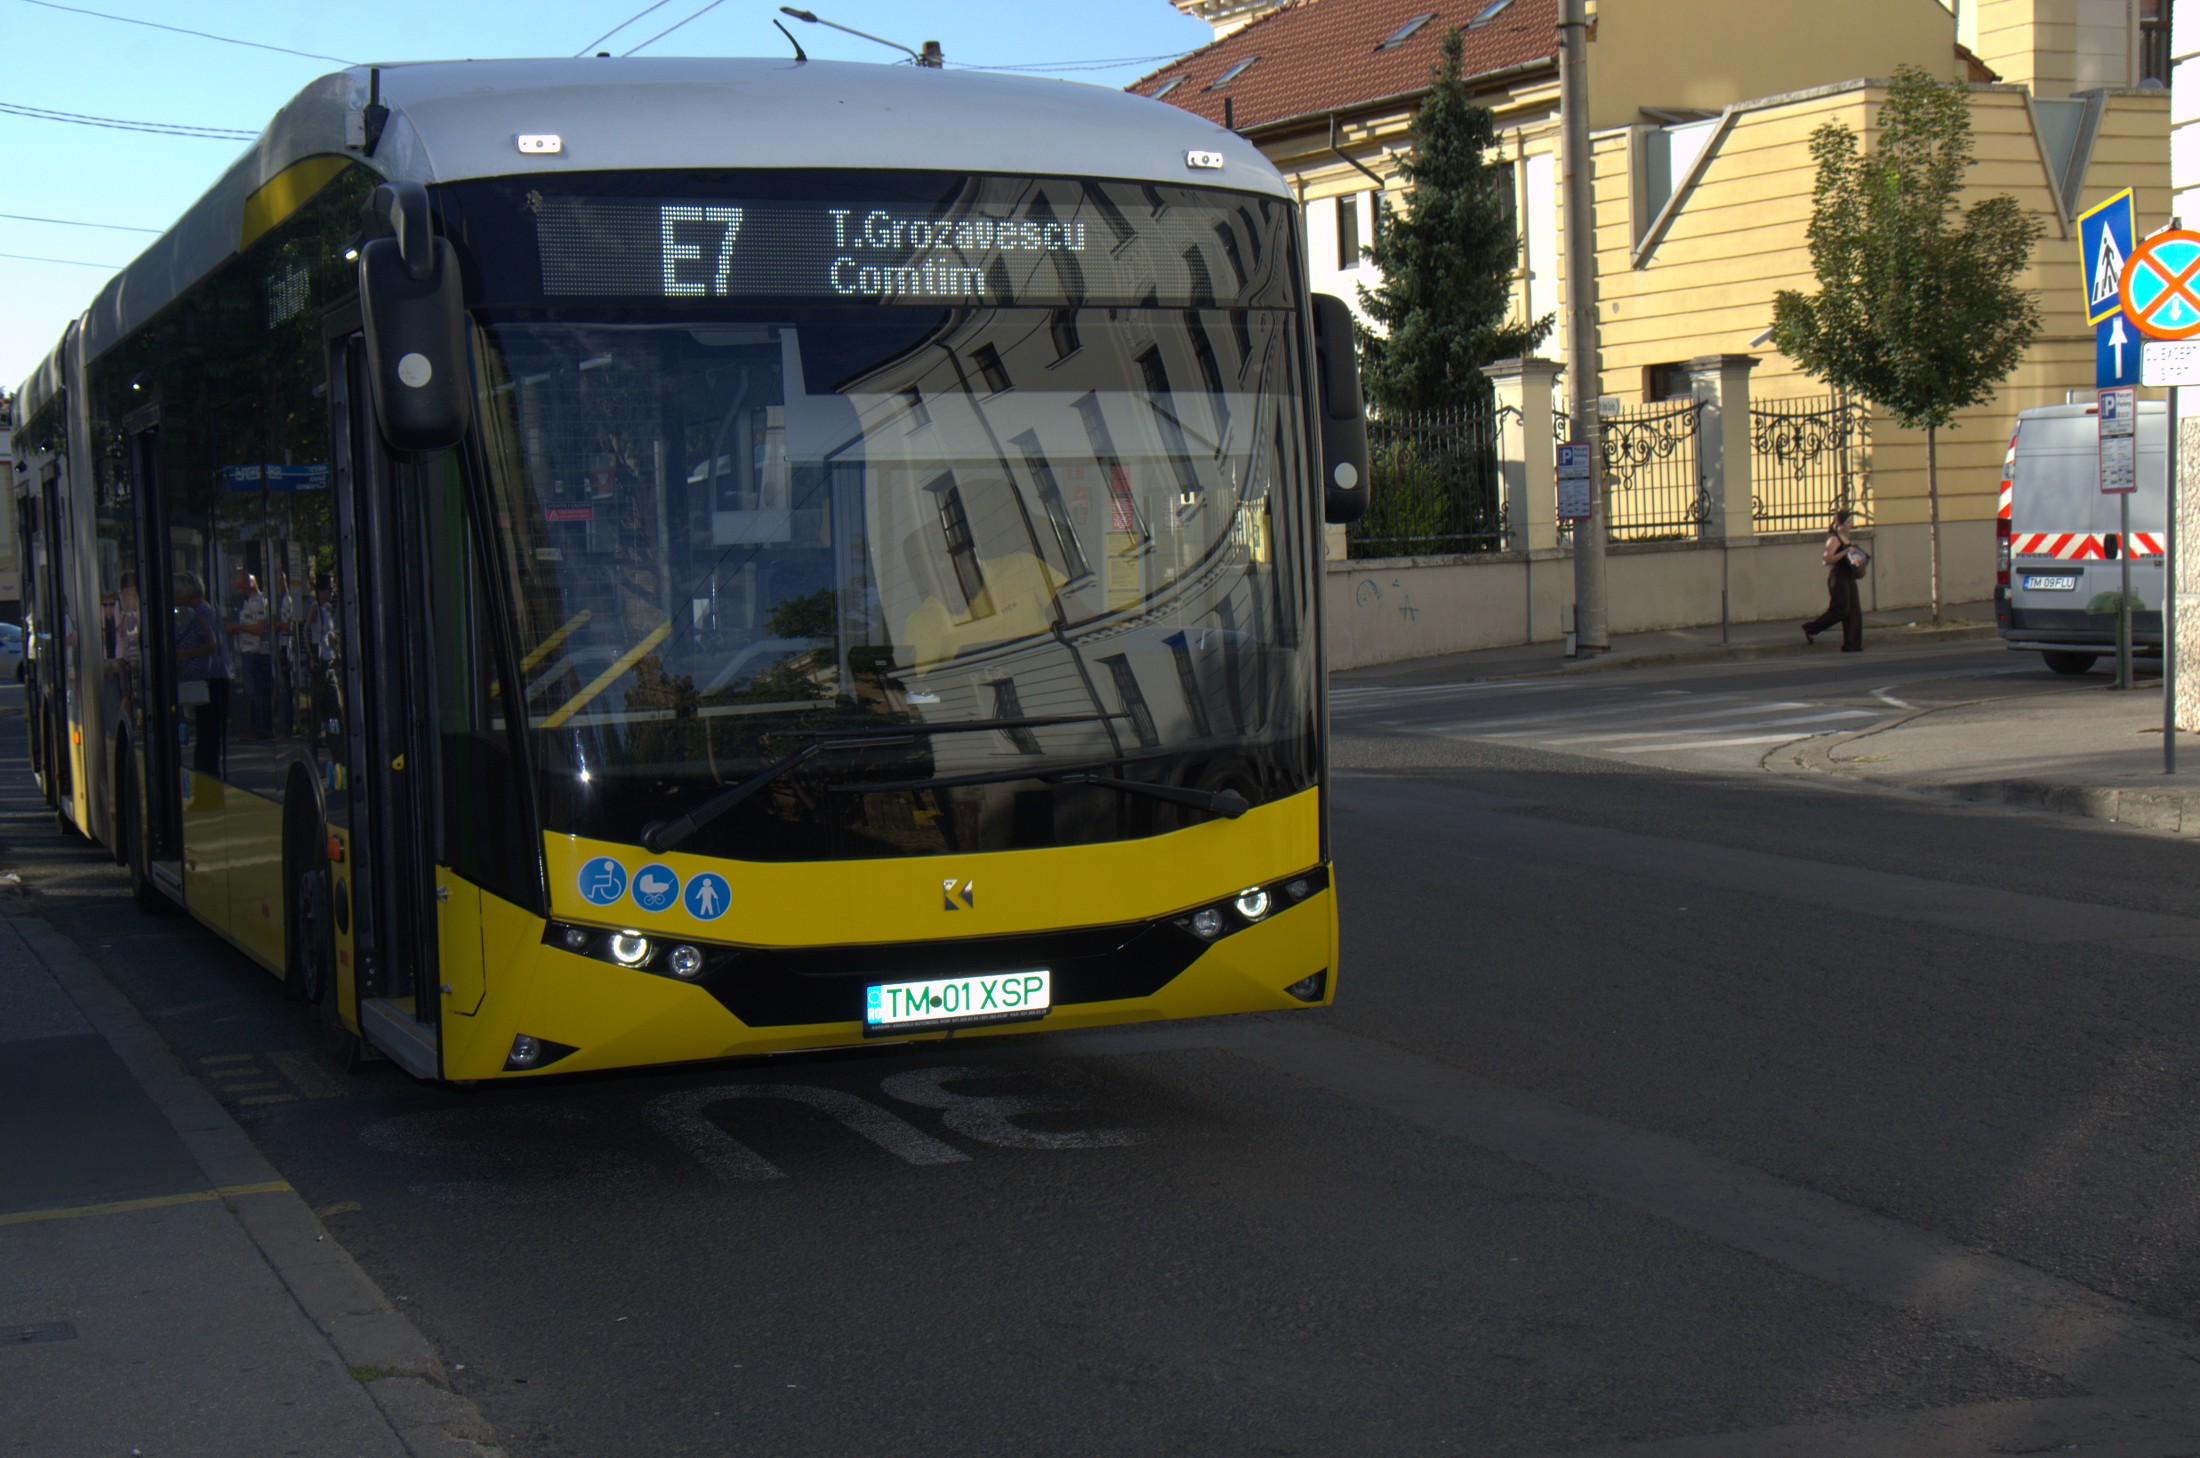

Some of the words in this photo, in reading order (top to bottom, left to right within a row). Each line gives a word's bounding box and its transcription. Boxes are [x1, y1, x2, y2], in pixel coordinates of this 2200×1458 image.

[828, 208, 1085, 251] T.Grozavescu
[660, 205, 744, 296] E7
[829, 256, 986, 295] Comtim
[2029, 577, 2042, 588] TM
[868, 1006, 882, 1021] RO
[886, 986, 930, 1018] TM
[980, 976, 1044, 1010] XSP
